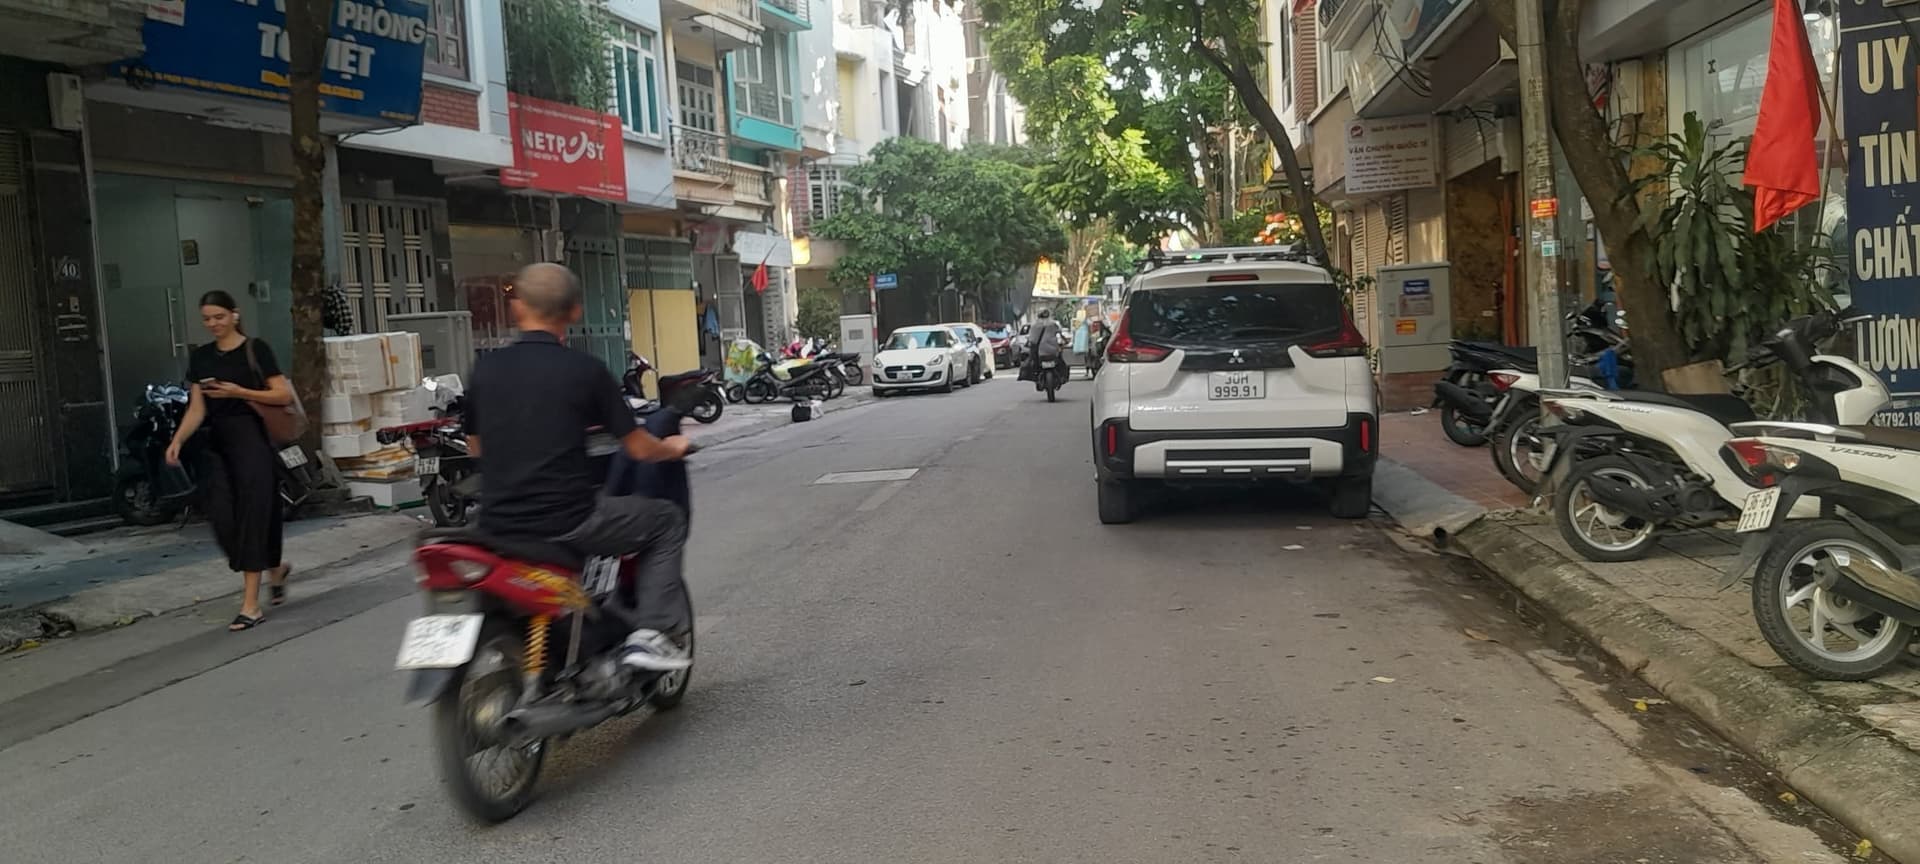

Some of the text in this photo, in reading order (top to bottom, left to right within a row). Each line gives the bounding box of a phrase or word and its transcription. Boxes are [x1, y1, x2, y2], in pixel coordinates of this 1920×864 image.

[337, 0, 425, 45] PHÒNG
[1857, 35, 1910, 95] UY
[521, 127, 605, 164] NETPOST
[1858, 121, 1918, 188] TÍN
[62, 263, 77, 277] 40
[1214, 385, 1257, 398] 999.91
[1828, 445, 1897, 460] VISION
